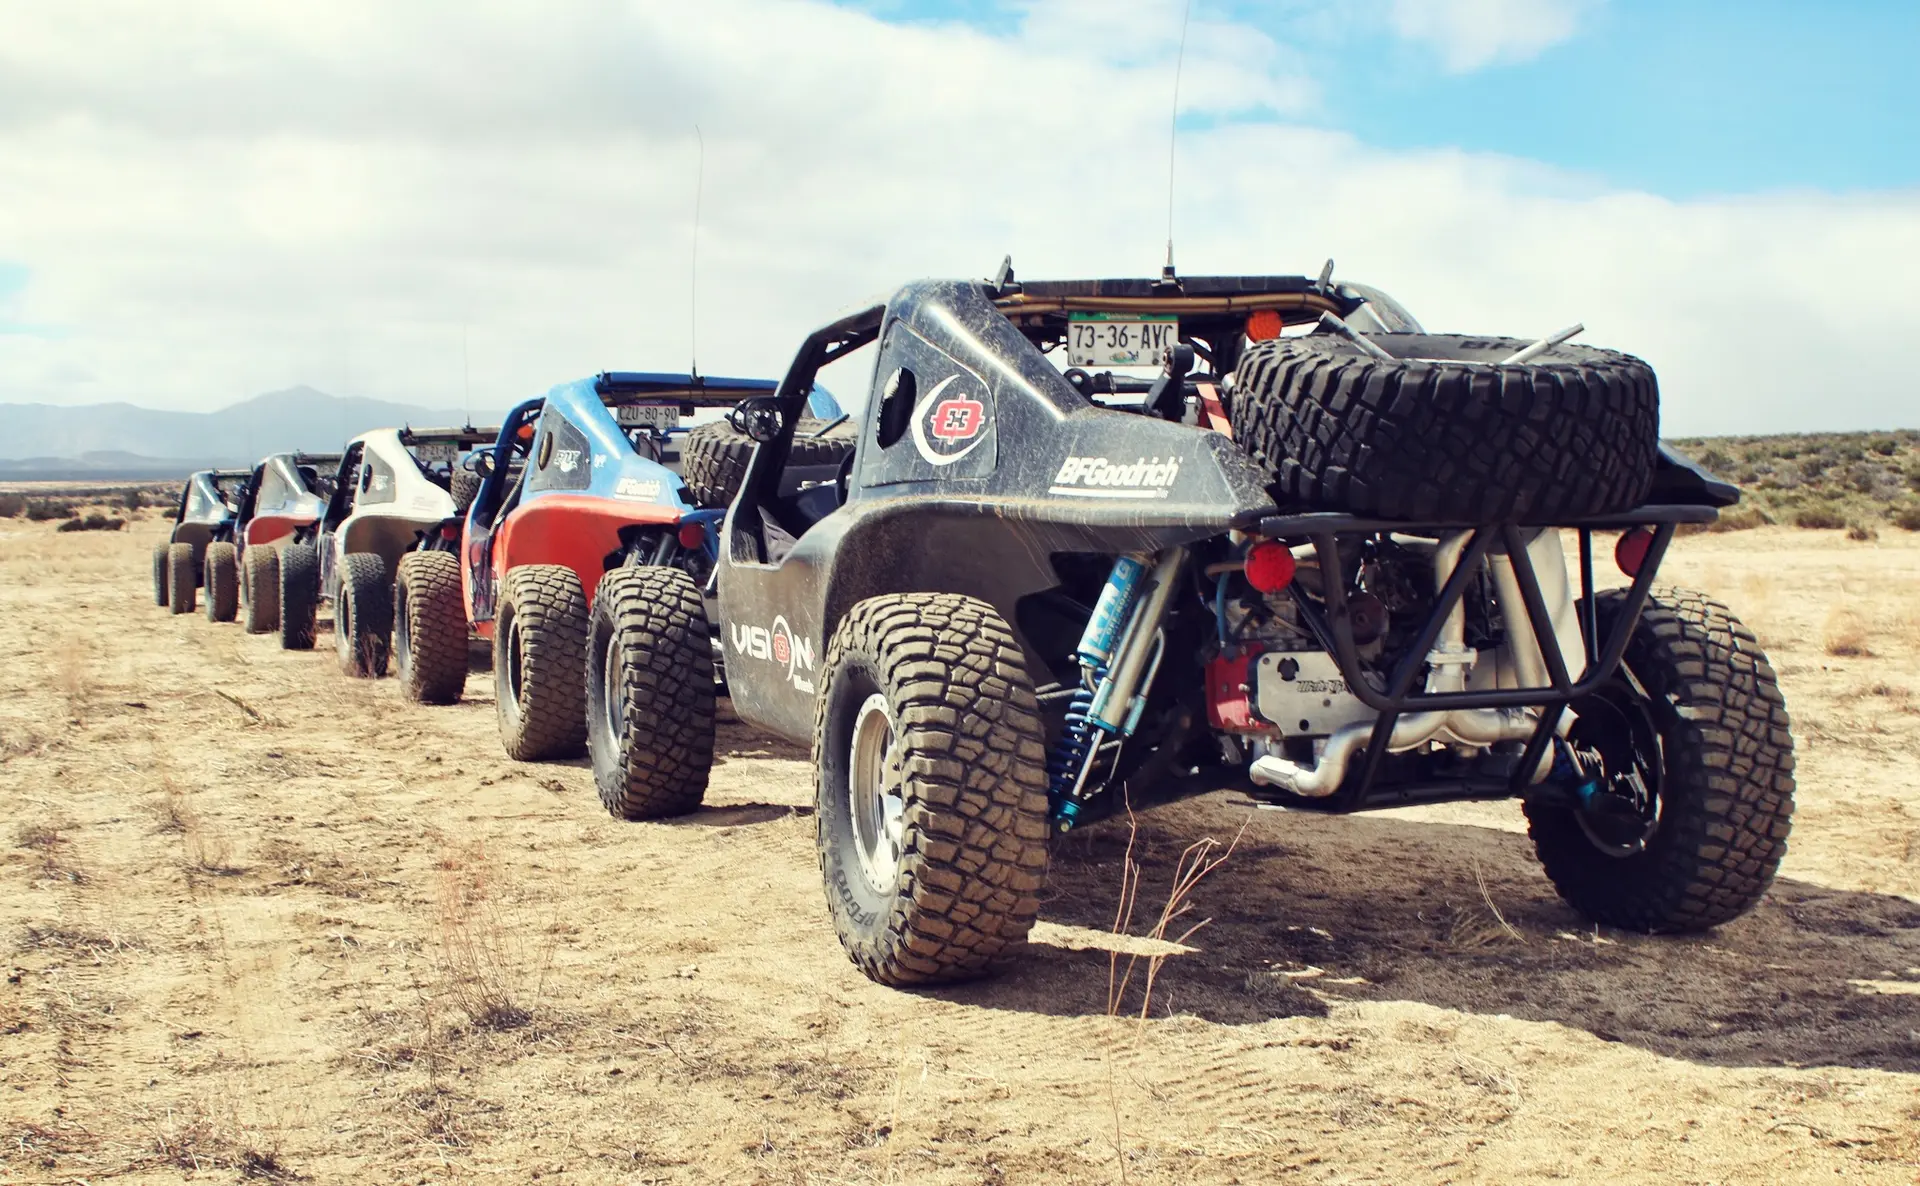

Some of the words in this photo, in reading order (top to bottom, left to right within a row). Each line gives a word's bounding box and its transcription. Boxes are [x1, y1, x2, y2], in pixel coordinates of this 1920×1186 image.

[1073, 324, 1173, 349] 73-36-AVC
[619, 406, 677, 420] CZU-80-90
[1054, 456, 1180, 486] BFGoodrich
